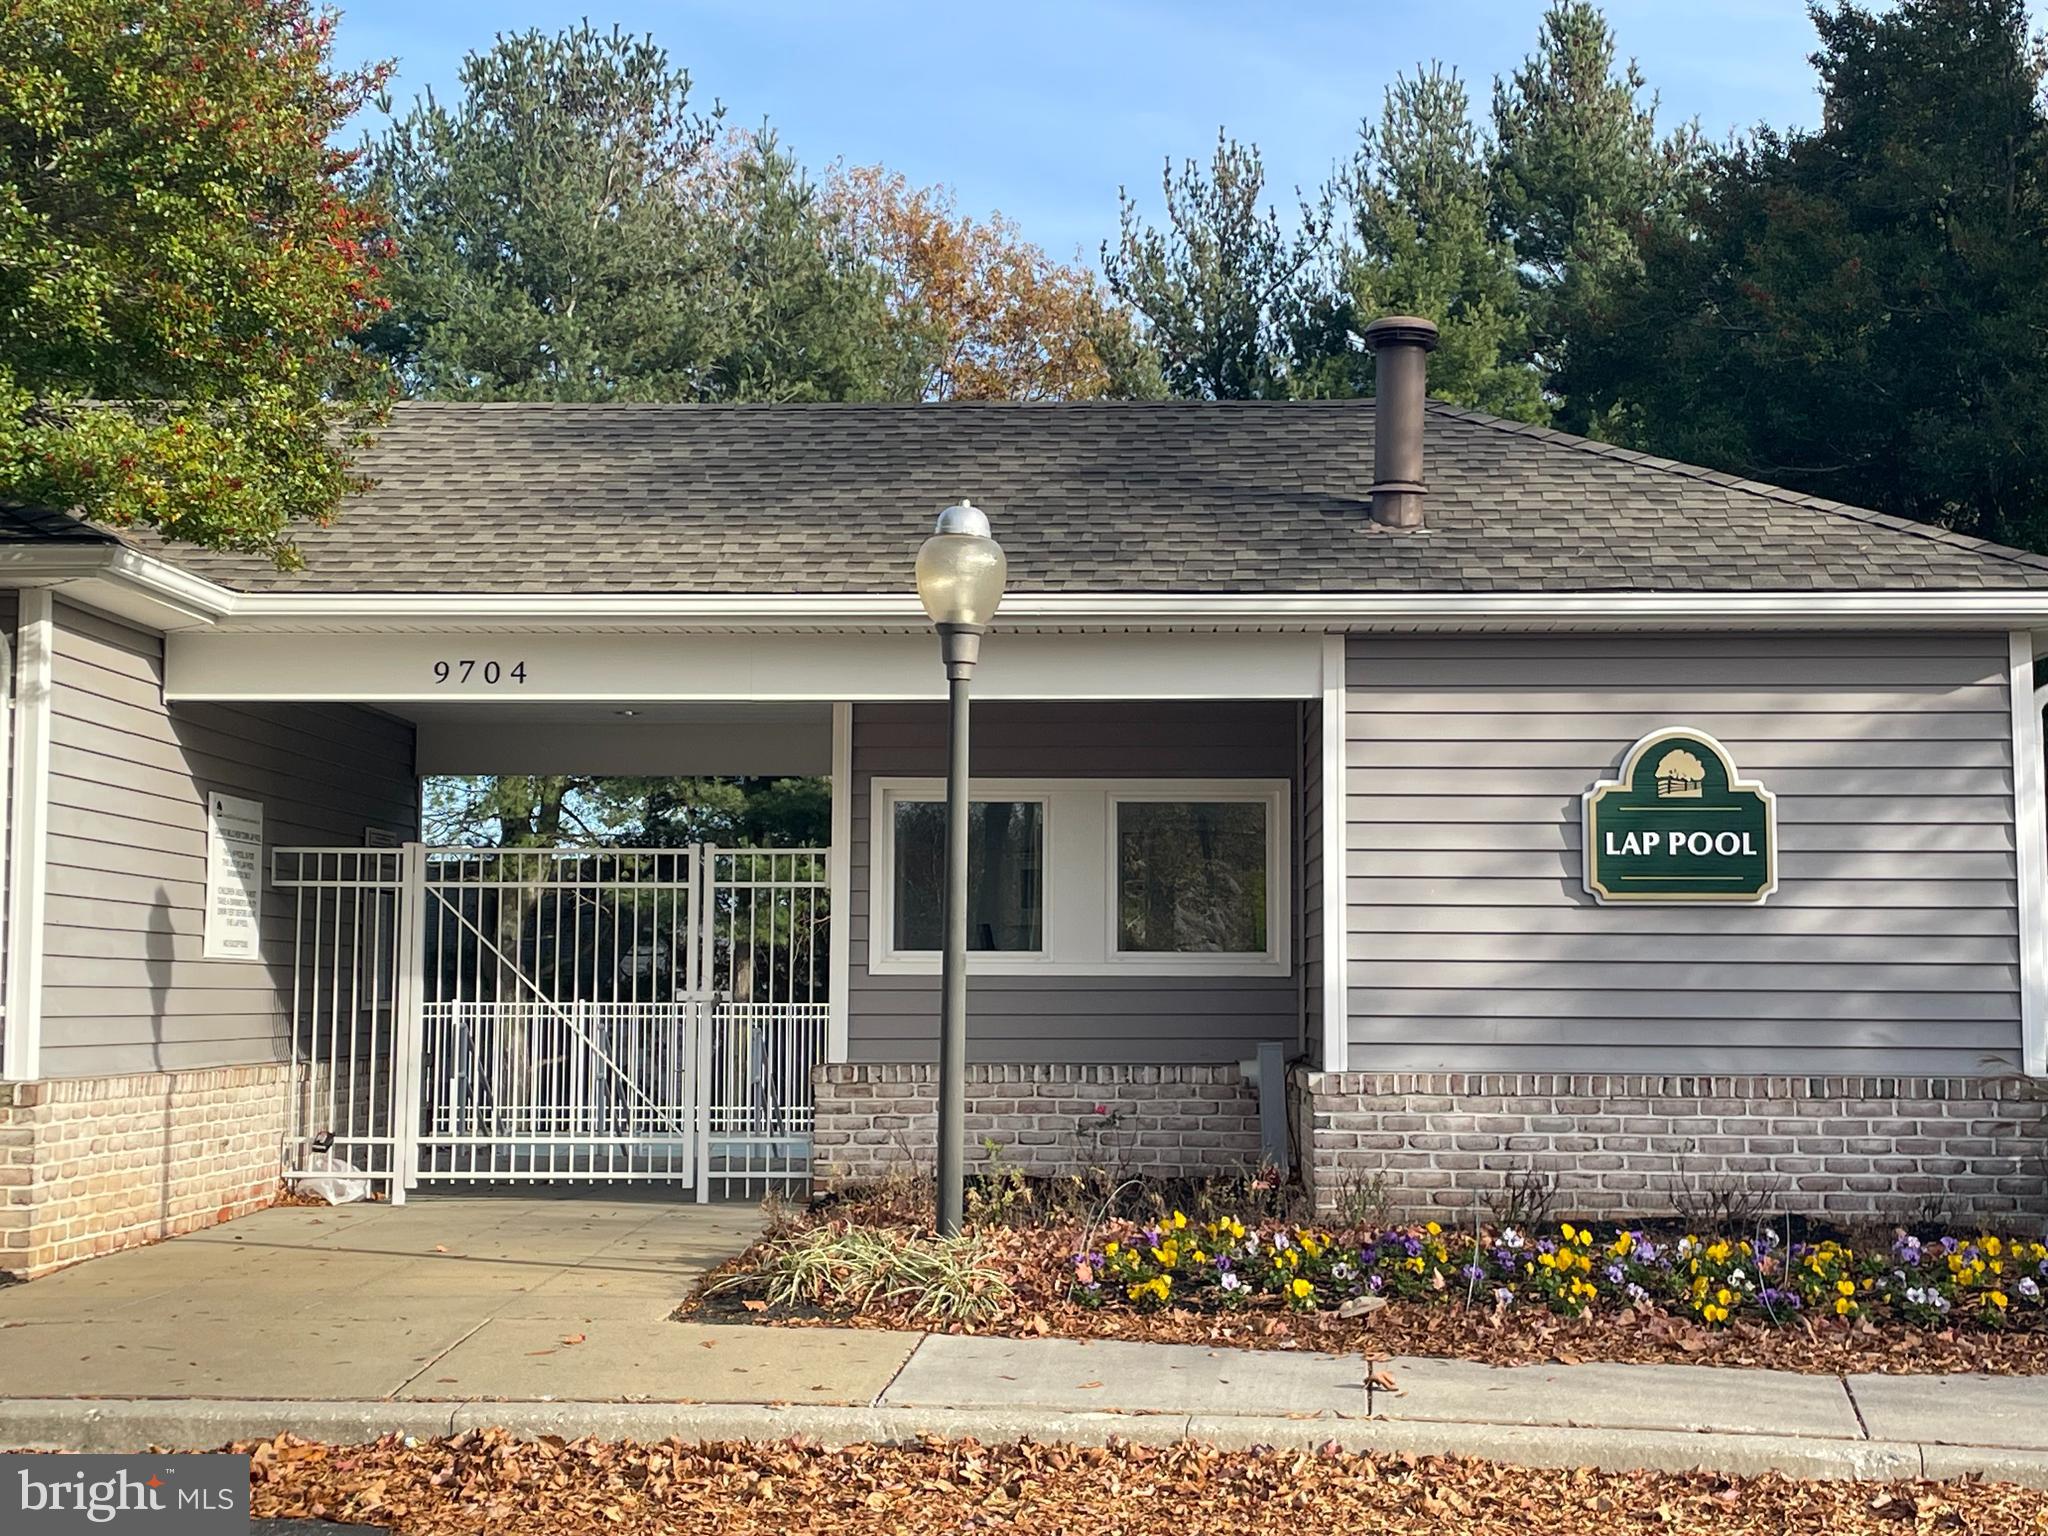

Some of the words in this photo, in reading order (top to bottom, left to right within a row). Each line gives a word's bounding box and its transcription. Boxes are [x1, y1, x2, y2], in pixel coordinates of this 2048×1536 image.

[434, 660, 527, 684] 9704
[1605, 831, 1660, 856] LAP
[1668, 831, 1757, 856] POOL
